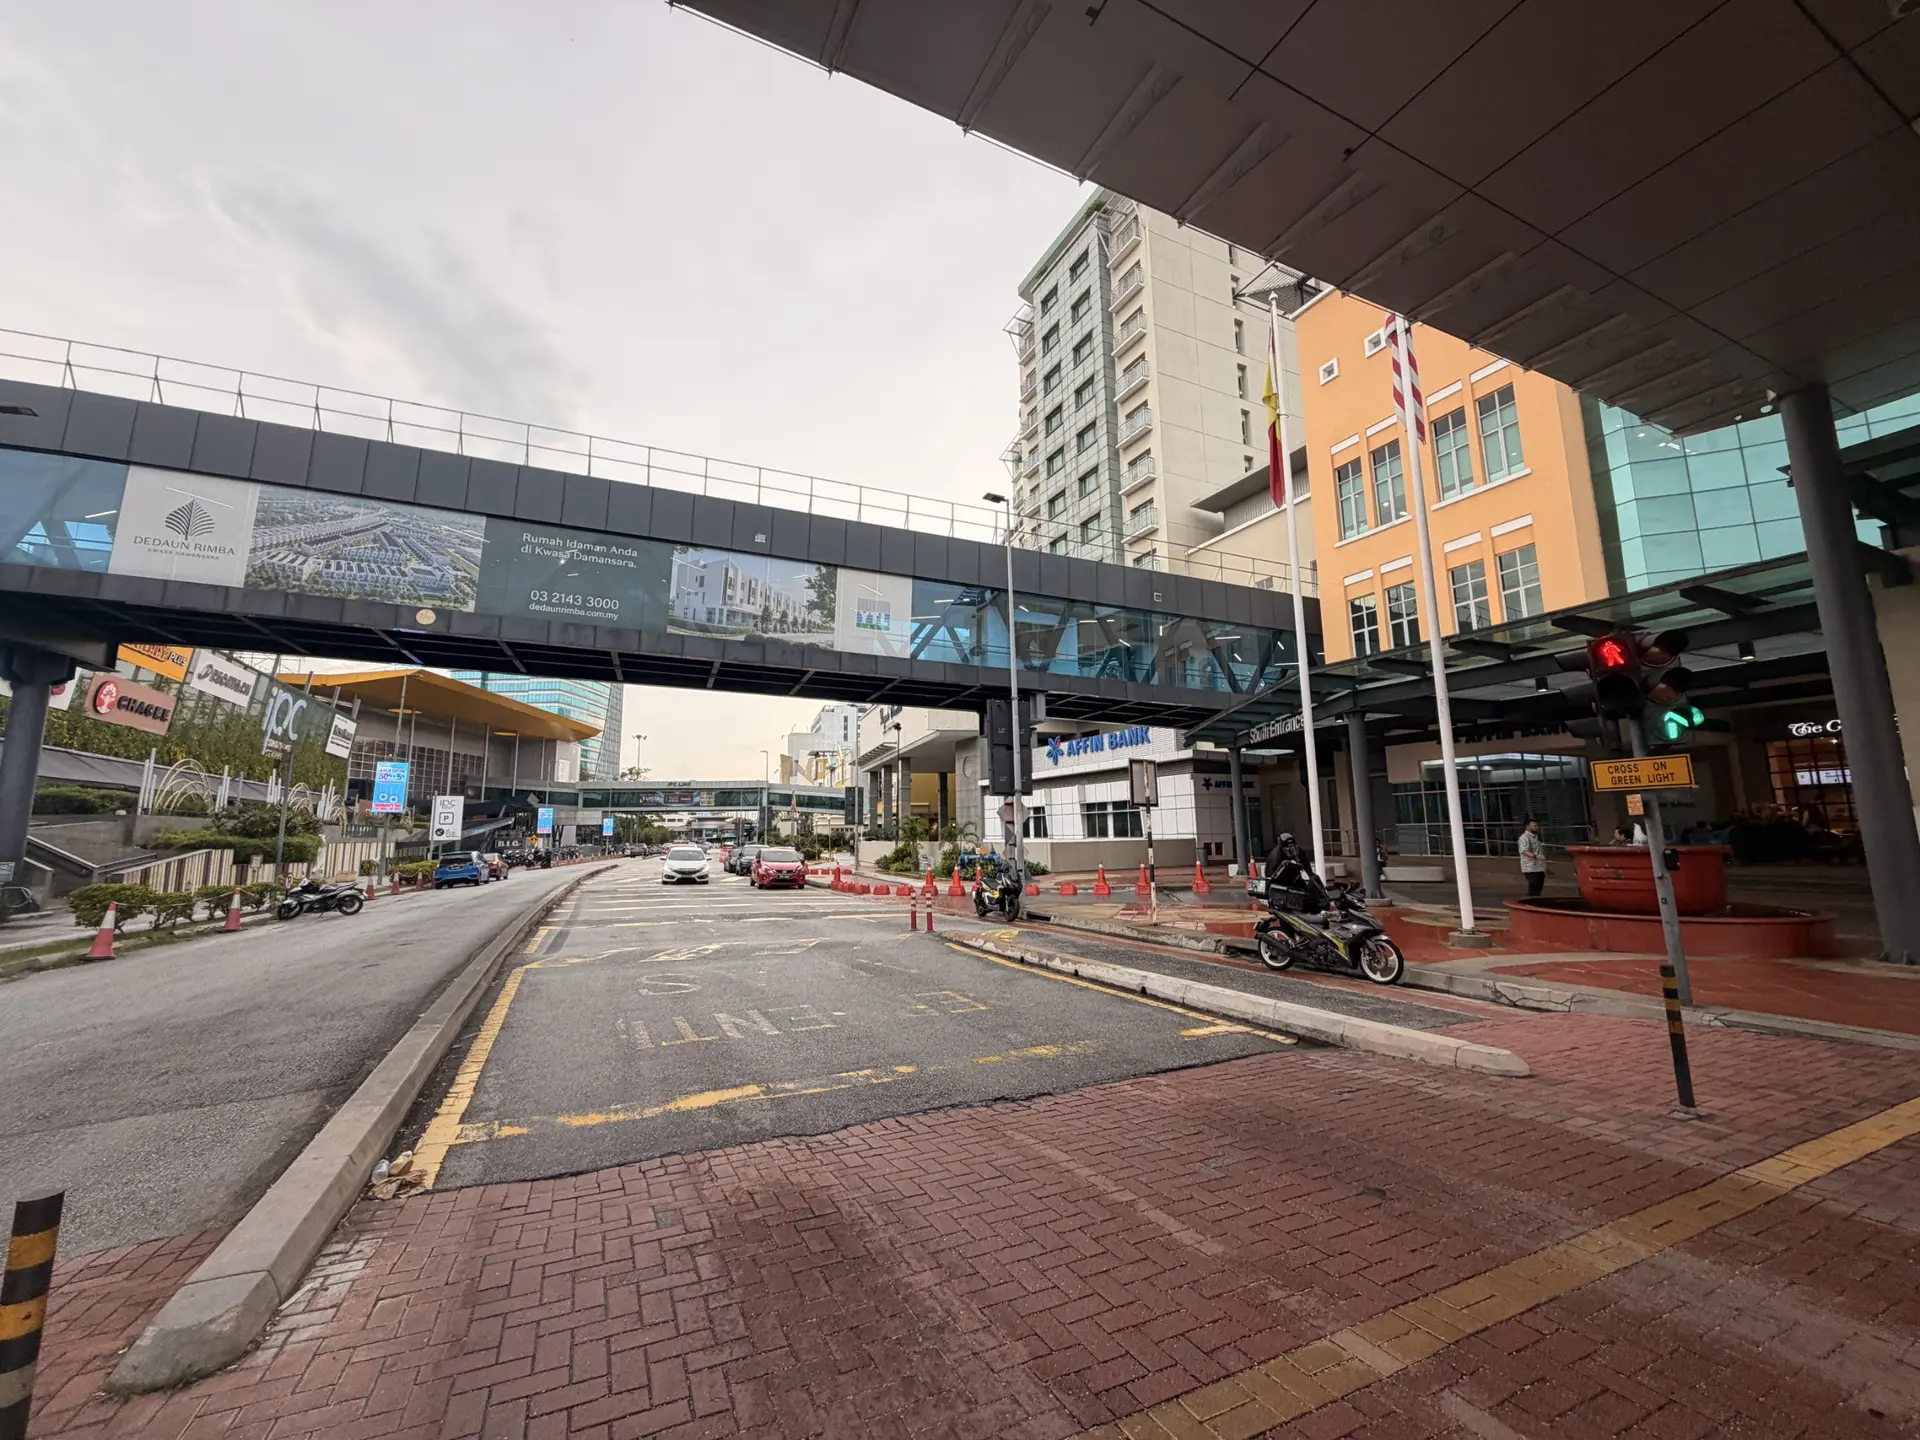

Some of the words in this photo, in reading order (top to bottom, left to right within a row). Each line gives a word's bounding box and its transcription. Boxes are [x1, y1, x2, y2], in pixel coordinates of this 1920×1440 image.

[133, 535, 190, 550] DEDAUN
[193, 543, 235, 556] RIMBA
[522, 532, 563, 547] Rumah
[566, 539, 607, 553] Idaman
[609, 546, 638, 557] Anda
[175, 551, 220, 560] DAMANSARA
[520, 544, 532, 554] di
[535, 546, 570, 559] Kwasa
[573, 552, 637, 568] Damansara.
[530, 590, 548, 602] 03
[551, 592, 582, 606] 2143
[586, 597, 620, 610] 3000
[528, 603, 619, 621] dedaunrimba.com.my
[168, 652, 188, 667] PLUS
[117, 695, 172, 723] CHAGEE
[1249, 724, 1270, 744] South
[1787, 721, 1823, 737] The
[1066, 734, 1105, 757] AFFIN
[1108, 726, 1151, 750] BANK
[1607, 763, 1640, 775] CROSS
[1652, 761, 1667, 772] ON
[1610, 775, 1641, 786] GREEN
[1647, 772, 1676, 784] LIGHT
